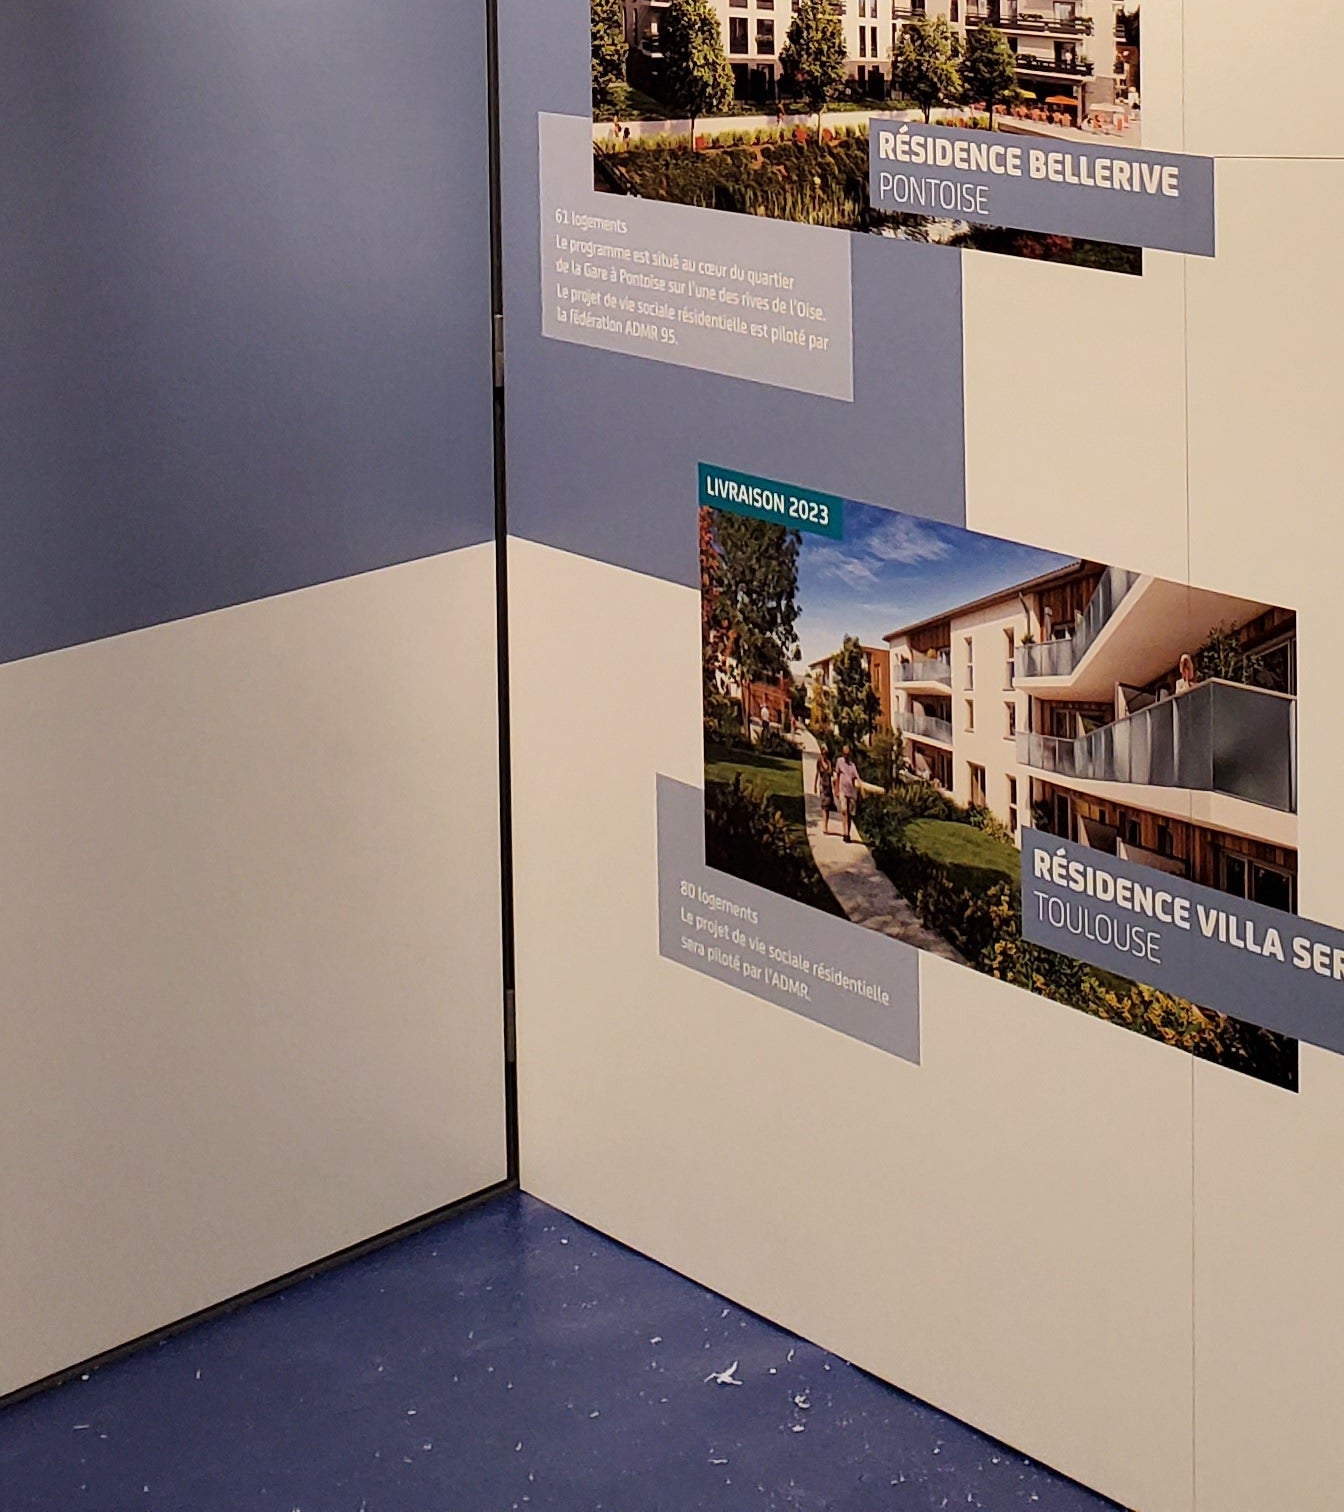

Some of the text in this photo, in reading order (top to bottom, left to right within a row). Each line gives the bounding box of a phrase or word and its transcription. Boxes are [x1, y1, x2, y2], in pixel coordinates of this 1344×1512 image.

[879, 125, 1180, 198] RÉSIDENCE BELLERIVE
[880, 172, 989, 216] PONTOISE
[571, 210, 628, 234] logements
[569, 237, 795, 291] programme situé quartier
[583, 262, 769, 311] Gare Pontoise rives
[569, 307, 659, 341] fédération ADMR
[570, 287, 806, 347] projet sociale résidentielle piloté
[706, 475, 829, 526] LIVRAISON 2023
[680, 879, 758, 925] 80 logements
[1033, 848, 1191, 931] RÉSIDENCE
[1196, 904, 1284, 963] VILLA
[1034, 890, 1161, 965] TOULOUSE
[680, 936, 705, 956] sera
[707, 946, 741, 971] piloté
[742, 961, 763, 981] par
[696, 914, 891, 1007] projet vie sociale résidentielle
